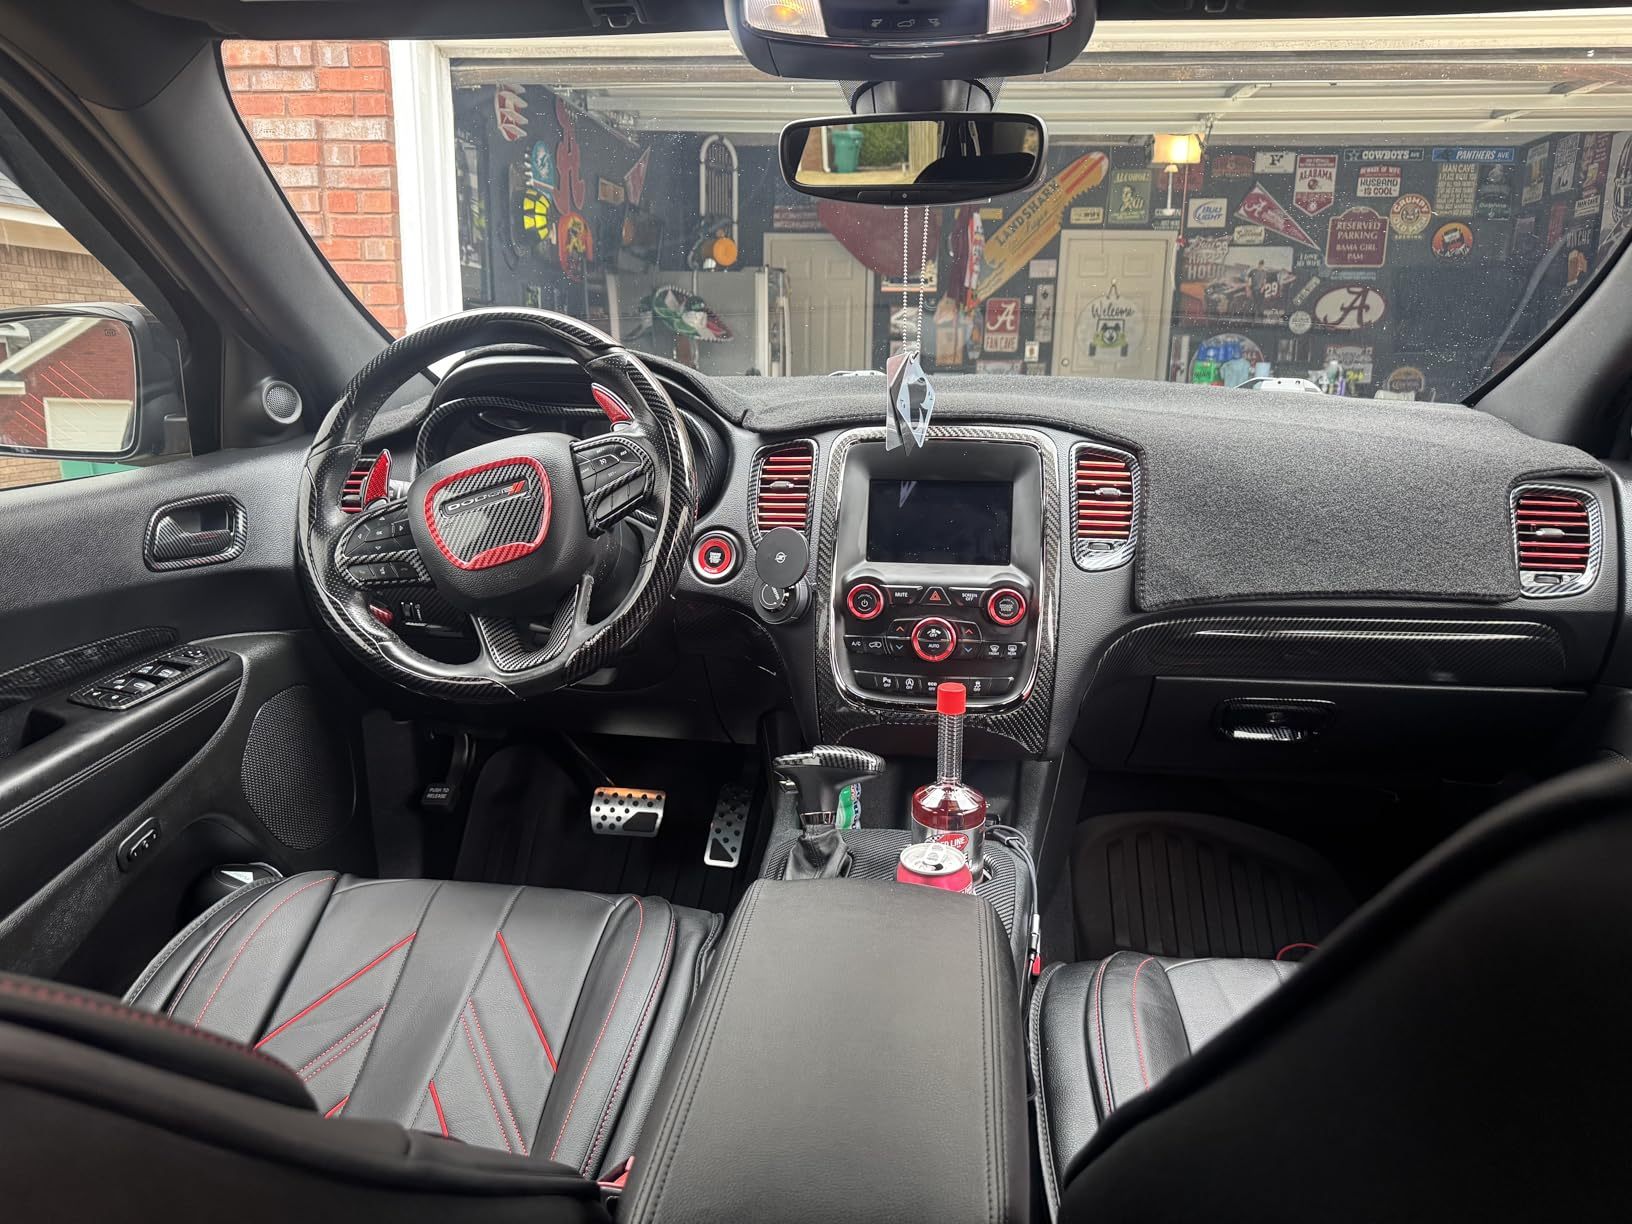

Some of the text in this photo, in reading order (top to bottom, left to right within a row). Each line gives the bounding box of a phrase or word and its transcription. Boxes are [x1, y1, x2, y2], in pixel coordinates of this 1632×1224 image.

[1362, 150, 1409, 160] COWBOYS
[1455, 150, 1496, 160] PANTHERS
[1442, 163, 1475, 173] MAN CAVE
[1299, 168, 1333, 182] ALABAMA
[1360, 179, 1398, 187] HUSBAND
[1364, 187, 1393, 195] IS COOL
[1393, 196, 1429, 212] GRUMPY
[995, 178, 1060, 247] LANDSHARK
[1199, 213, 1223, 221] LIGHT
[1336, 221, 1381, 230] RESERVED
[1393, 217, 1408, 231] OLD
[1337, 231, 1378, 240] PARKING
[1336, 243, 1377, 251] BAMA GIRL
[1264, 281, 1278, 298] 29
[1091, 301, 1135, 319] Welcome
[986, 335, 999, 350] FAN
[950, 836, 966, 848] LINE
